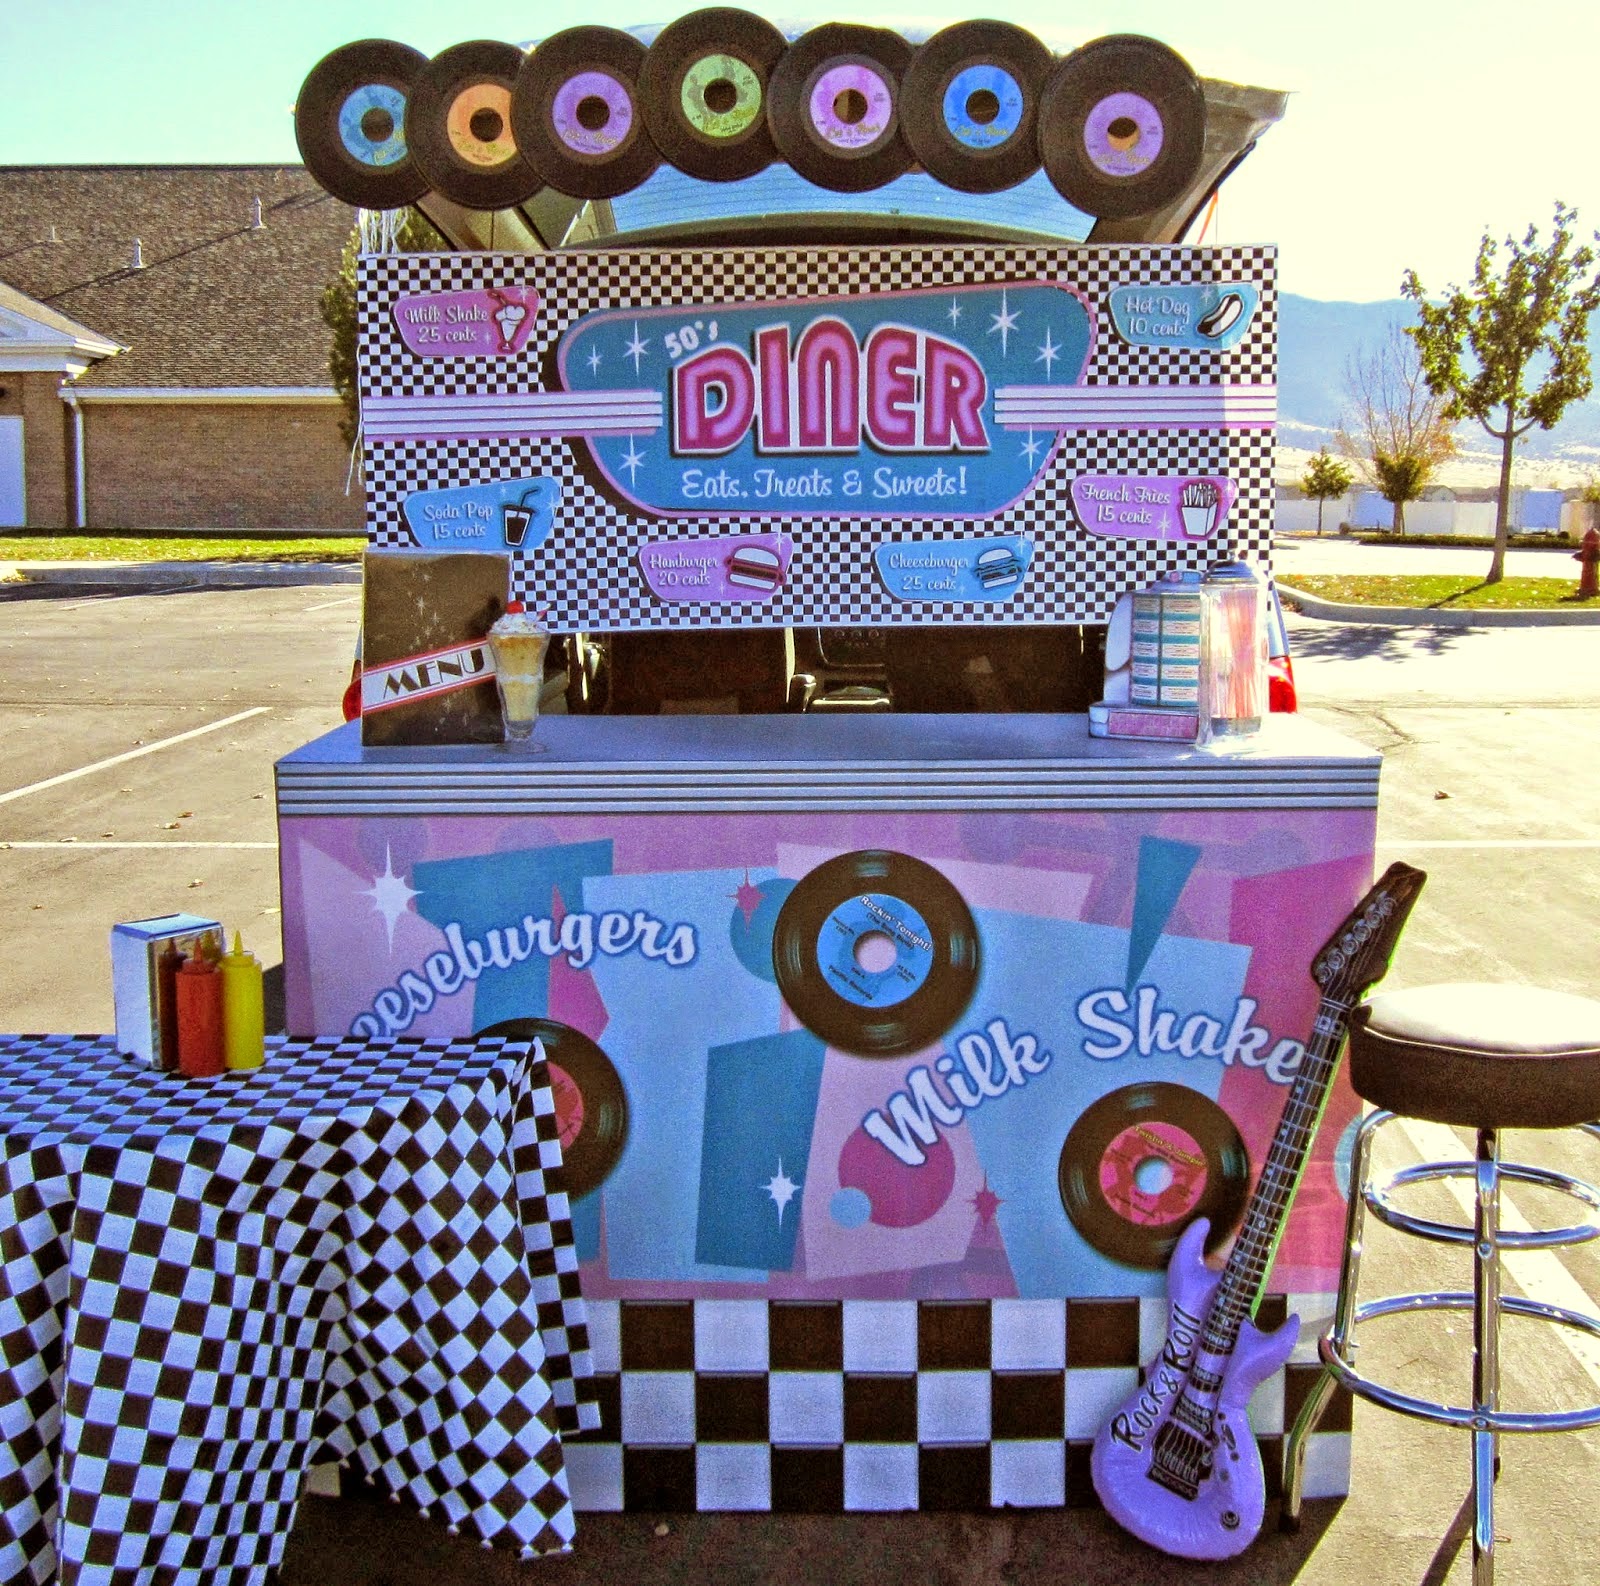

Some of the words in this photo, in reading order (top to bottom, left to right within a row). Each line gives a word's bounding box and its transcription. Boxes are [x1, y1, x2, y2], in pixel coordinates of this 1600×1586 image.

[404, 305, 440, 323] Milk
[445, 304, 488, 323] Shake
[1126, 296, 1154, 313] Hot
[1156, 295, 1190, 324] Dog
[418, 326, 441, 343] 25
[445, 326, 477, 343] cents
[1130, 317, 1148, 335] 10
[1152, 320, 1186, 336] cents
[664, 320, 718, 358] 50's
[673, 315, 991, 452] DINER
[681, 468, 749, 498] Eats,
[753, 468, 832, 497] Treats
[843, 470, 862, 494] &
[872, 465, 967, 498] Sweets!
[1081, 482, 1131, 502] French
[1134, 486, 1171, 504] Fries
[424, 503, 460, 521] Soda
[462, 501, 493, 521] Pop
[1097, 504, 1115, 522] 15
[1119, 508, 1153, 524] cents
[433, 522, 451, 540] 15
[454, 522, 487, 538] cents
[649, 552, 719, 576] Hamburger
[889, 552, 971, 577] Cheeseburger
[658, 570, 678, 586] 20
[682, 570, 711, 586] cents
[902, 575, 924, 590] 25
[927, 576, 957, 590] cents
[382, 648, 485, 700] MENU
[861, 894, 896, 922] Rockin'
[894, 919, 933, 952] Tonight!
[351, 911, 696, 1036] eeseburgers
[864, 1021, 1051, 1166] Milk
[1078, 987, 1305, 1083] Shake
